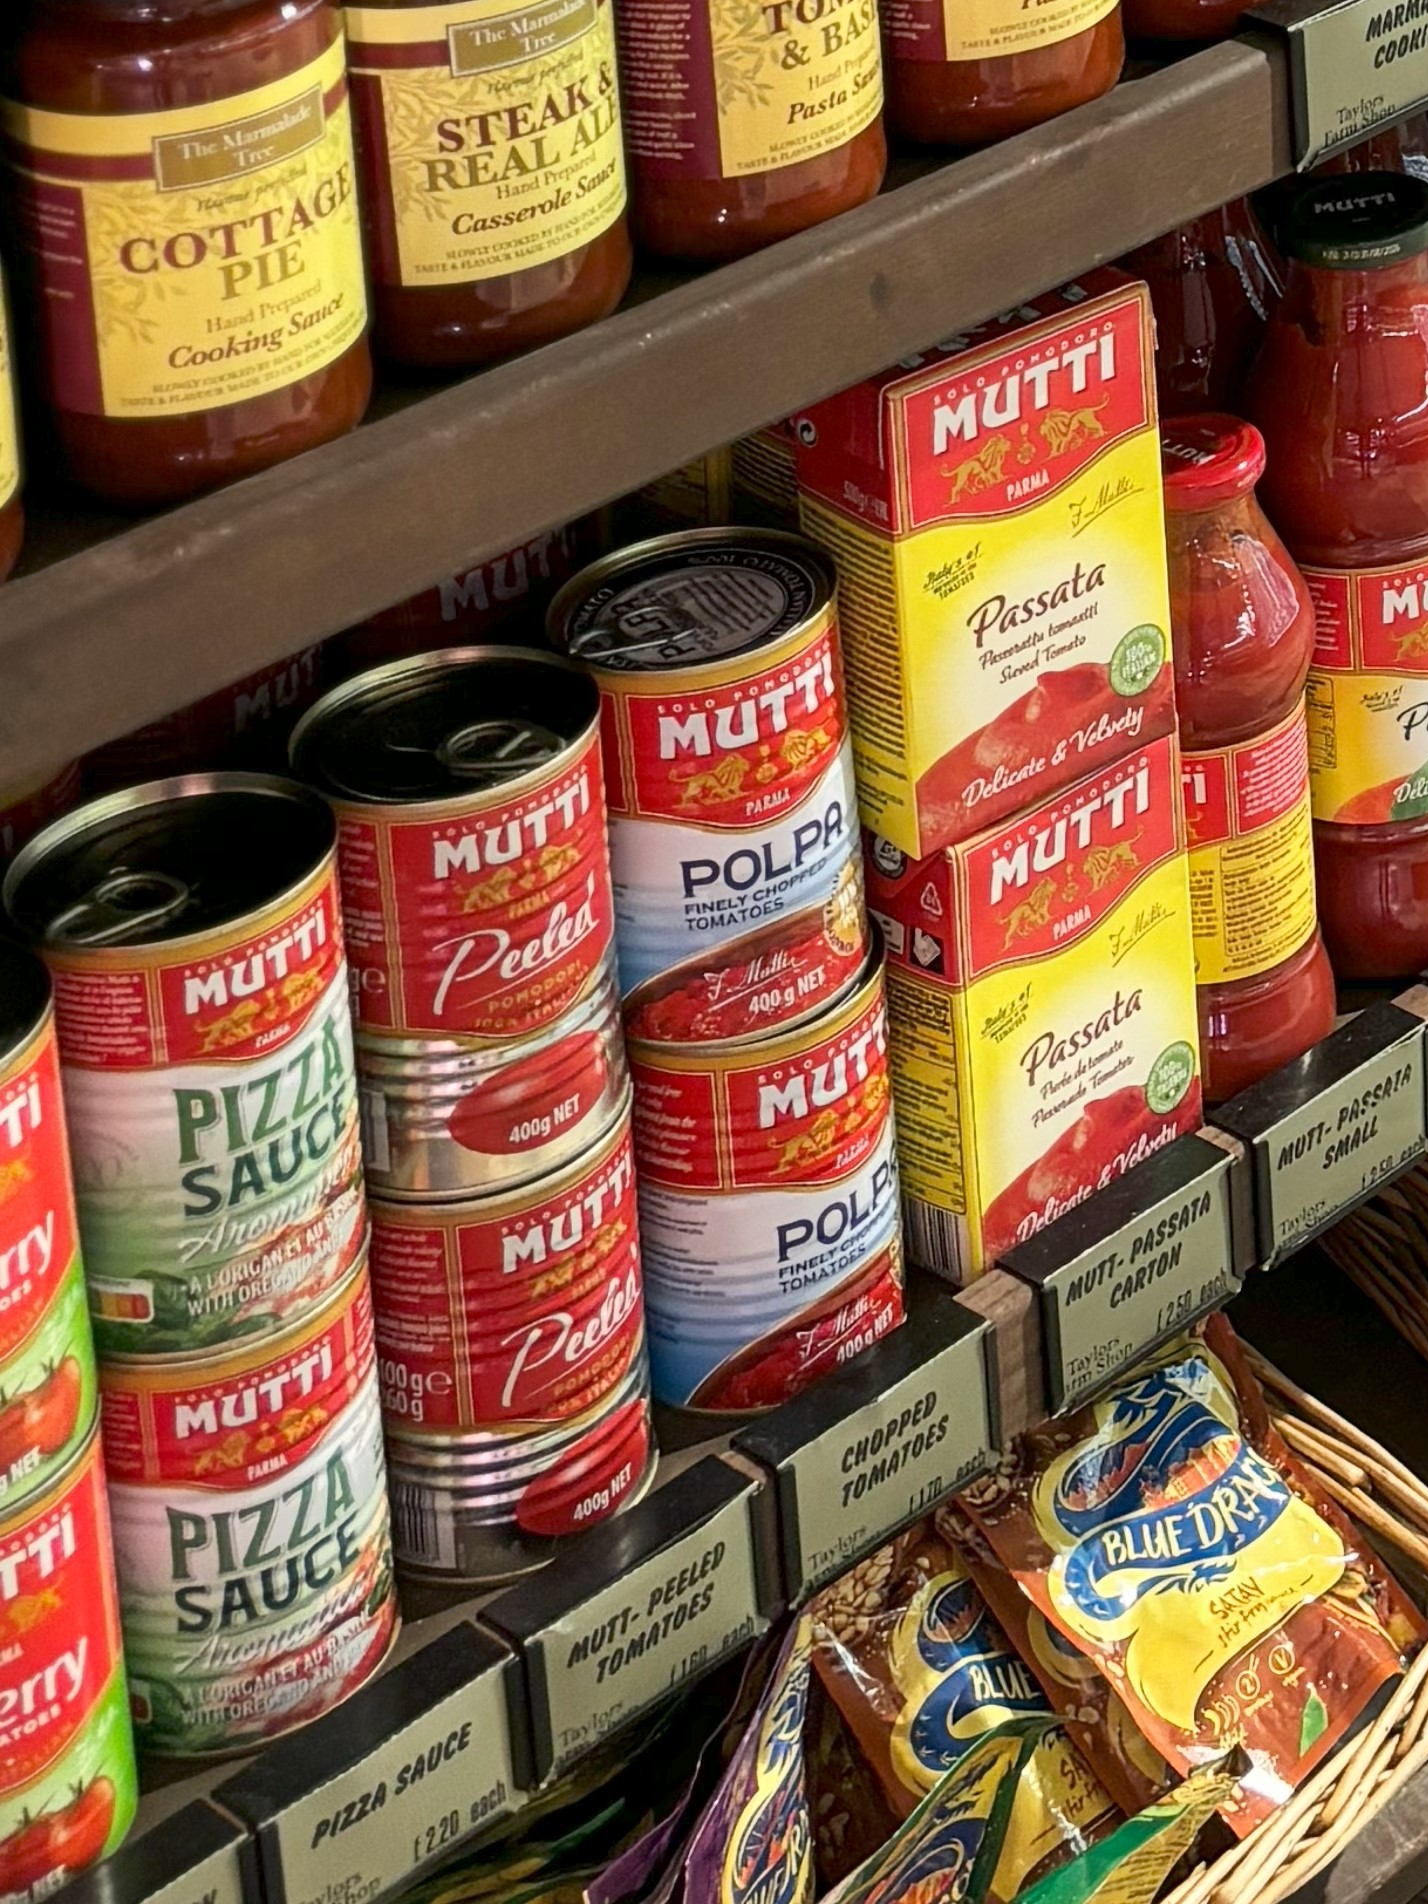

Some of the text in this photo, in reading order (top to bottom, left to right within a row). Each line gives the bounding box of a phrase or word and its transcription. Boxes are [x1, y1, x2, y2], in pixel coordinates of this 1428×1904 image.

[436, 65, 610, 153] STEAK &
[424, 133, 563, 193] REAL
[450, 161, 617, 237] Casserole Sauce
[118, 164, 350, 274] COTTAGE
[220, 241, 305, 302] PIE
[167, 292, 343, 371] Cooking Sauce
[931, 330, 1117, 457] MUTTI
[1005, 469, 1051, 502] PARMA
[966, 560, 1107, 649] Passata
[658, 667, 834, 760] MUTTI
[960, 702, 1144, 809] Delicate & Velvety
[431, 784, 590, 879] MUTTI
[681, 800, 844, 897] POLPA
[990, 765, 1151, 905] MUTTI
[684, 858, 827, 923] FINELY CHOPPED
[684, 897, 785, 932] TOMATOES
[183, 908, 328, 1013] MUTTI
[430, 882, 598, 1020] Peeled
[1021, 986, 1144, 1088] Passata
[174, 1017, 343, 1164] PIZZA
[508, 1095, 581, 1147] 400g NET
[183, 1088, 349, 1218] SAUCE
[1125, 1191, 1211, 1265] PASSATA
[1108, 1241, 1182, 1311] CARTON
[174, 1351, 332, 1440] MUTTI
[841, 1391, 935, 1474] CHOPPED
[573, 1463, 632, 1522] 400g NET
[841, 1415, 949, 1506] TOMATOES
[167, 1459, 354, 1580] PIZZA
[1100, 1515, 1188, 1563] BLUE
[176, 1517, 358, 1632] SAUCE
[1209, 1577, 1262, 1618] SATAY
[312, 1722, 472, 1850] PIZZA SAUCE
